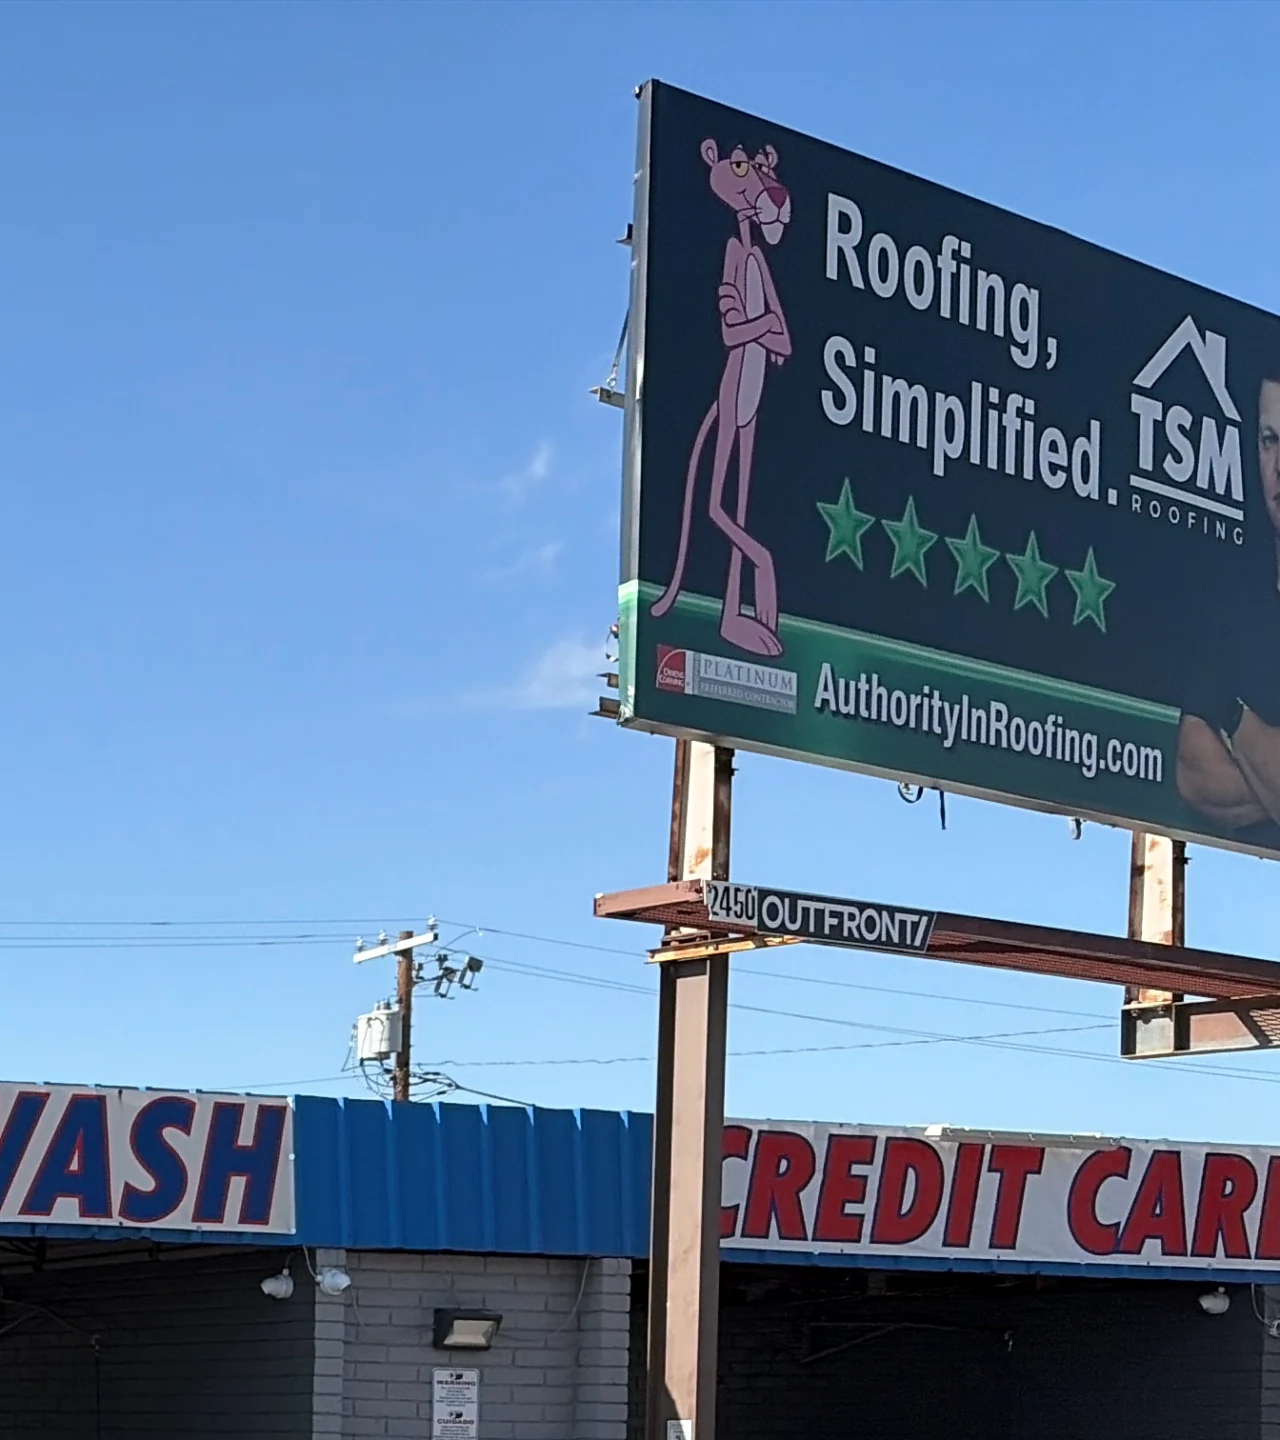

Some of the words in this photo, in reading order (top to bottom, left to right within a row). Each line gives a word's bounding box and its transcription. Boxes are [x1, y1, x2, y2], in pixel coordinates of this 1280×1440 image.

[825, 191, 1058, 369] Roofing,
[822, 335, 1118, 504] Simplified.
[1130, 393, 1245, 502] TSM
[1131, 494, 1245, 546] ROOFING
[703, 659, 793, 692] PLATINUM
[814, 663, 1163, 782] AuthorityInRoofing.com
